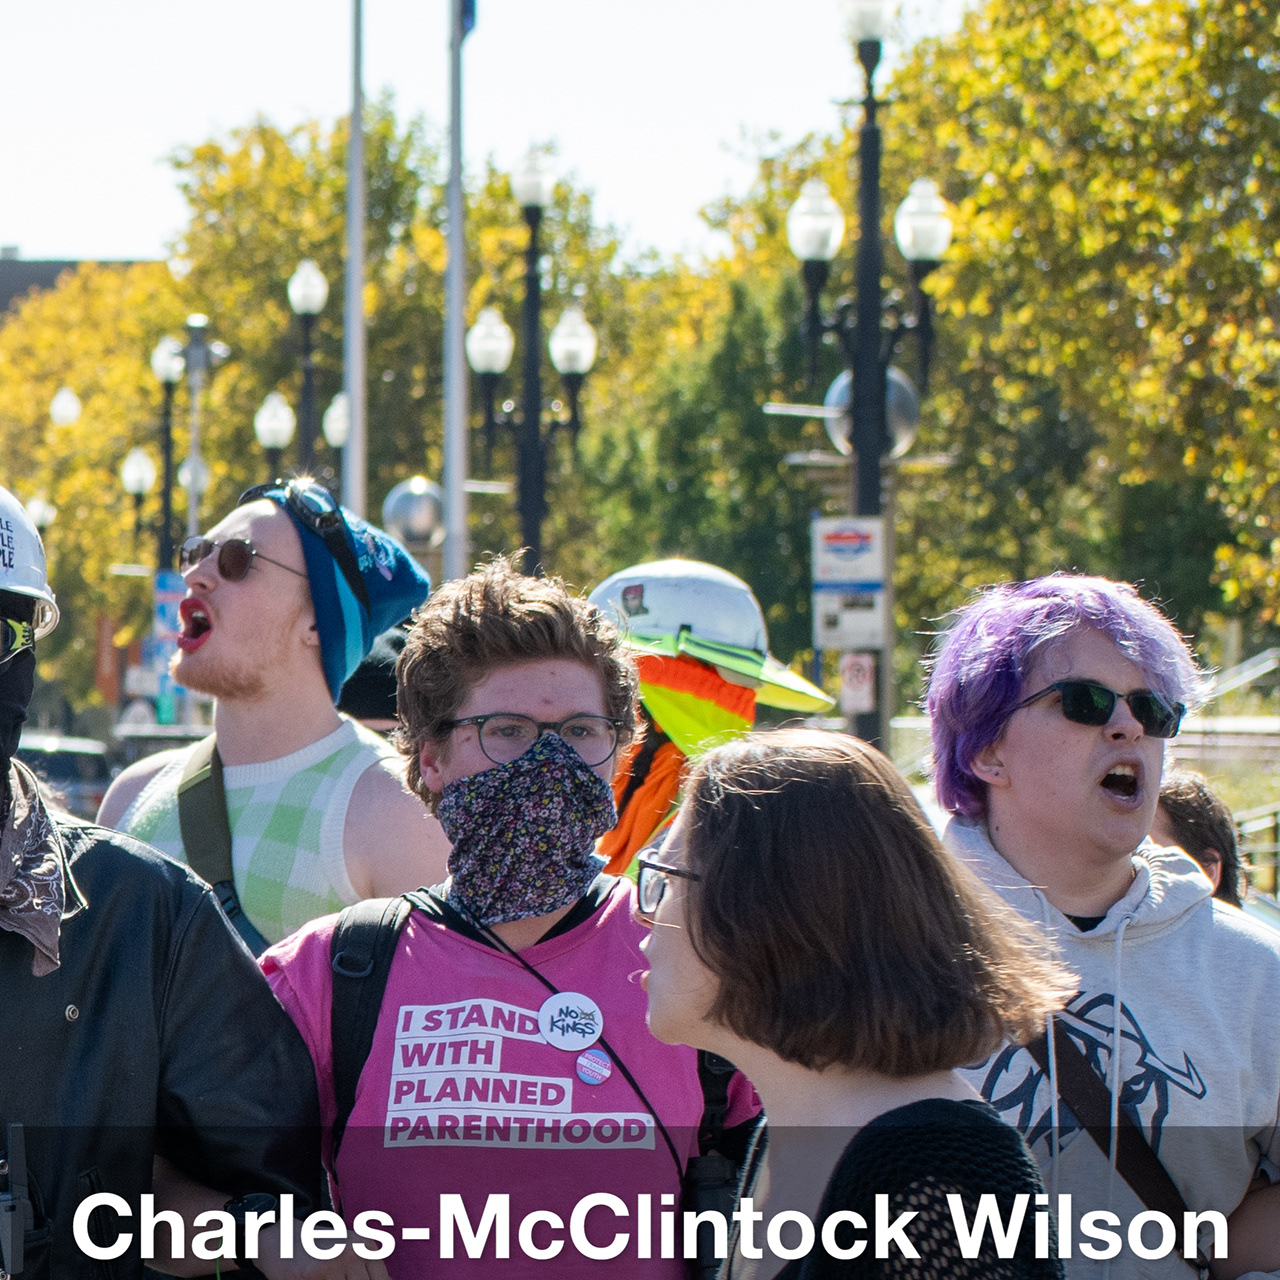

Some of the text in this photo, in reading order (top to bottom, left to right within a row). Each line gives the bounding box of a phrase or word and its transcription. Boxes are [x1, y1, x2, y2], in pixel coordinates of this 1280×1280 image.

[400, 1003, 540, 1037] I STAND
[559, 1005, 579, 1019] NO
[400, 1038, 495, 1068] WITH
[584, 1052, 610, 1069] PROTECT
[582, 1066, 603, 1080] YOUTH
[393, 1077, 566, 1107] PLANNED
